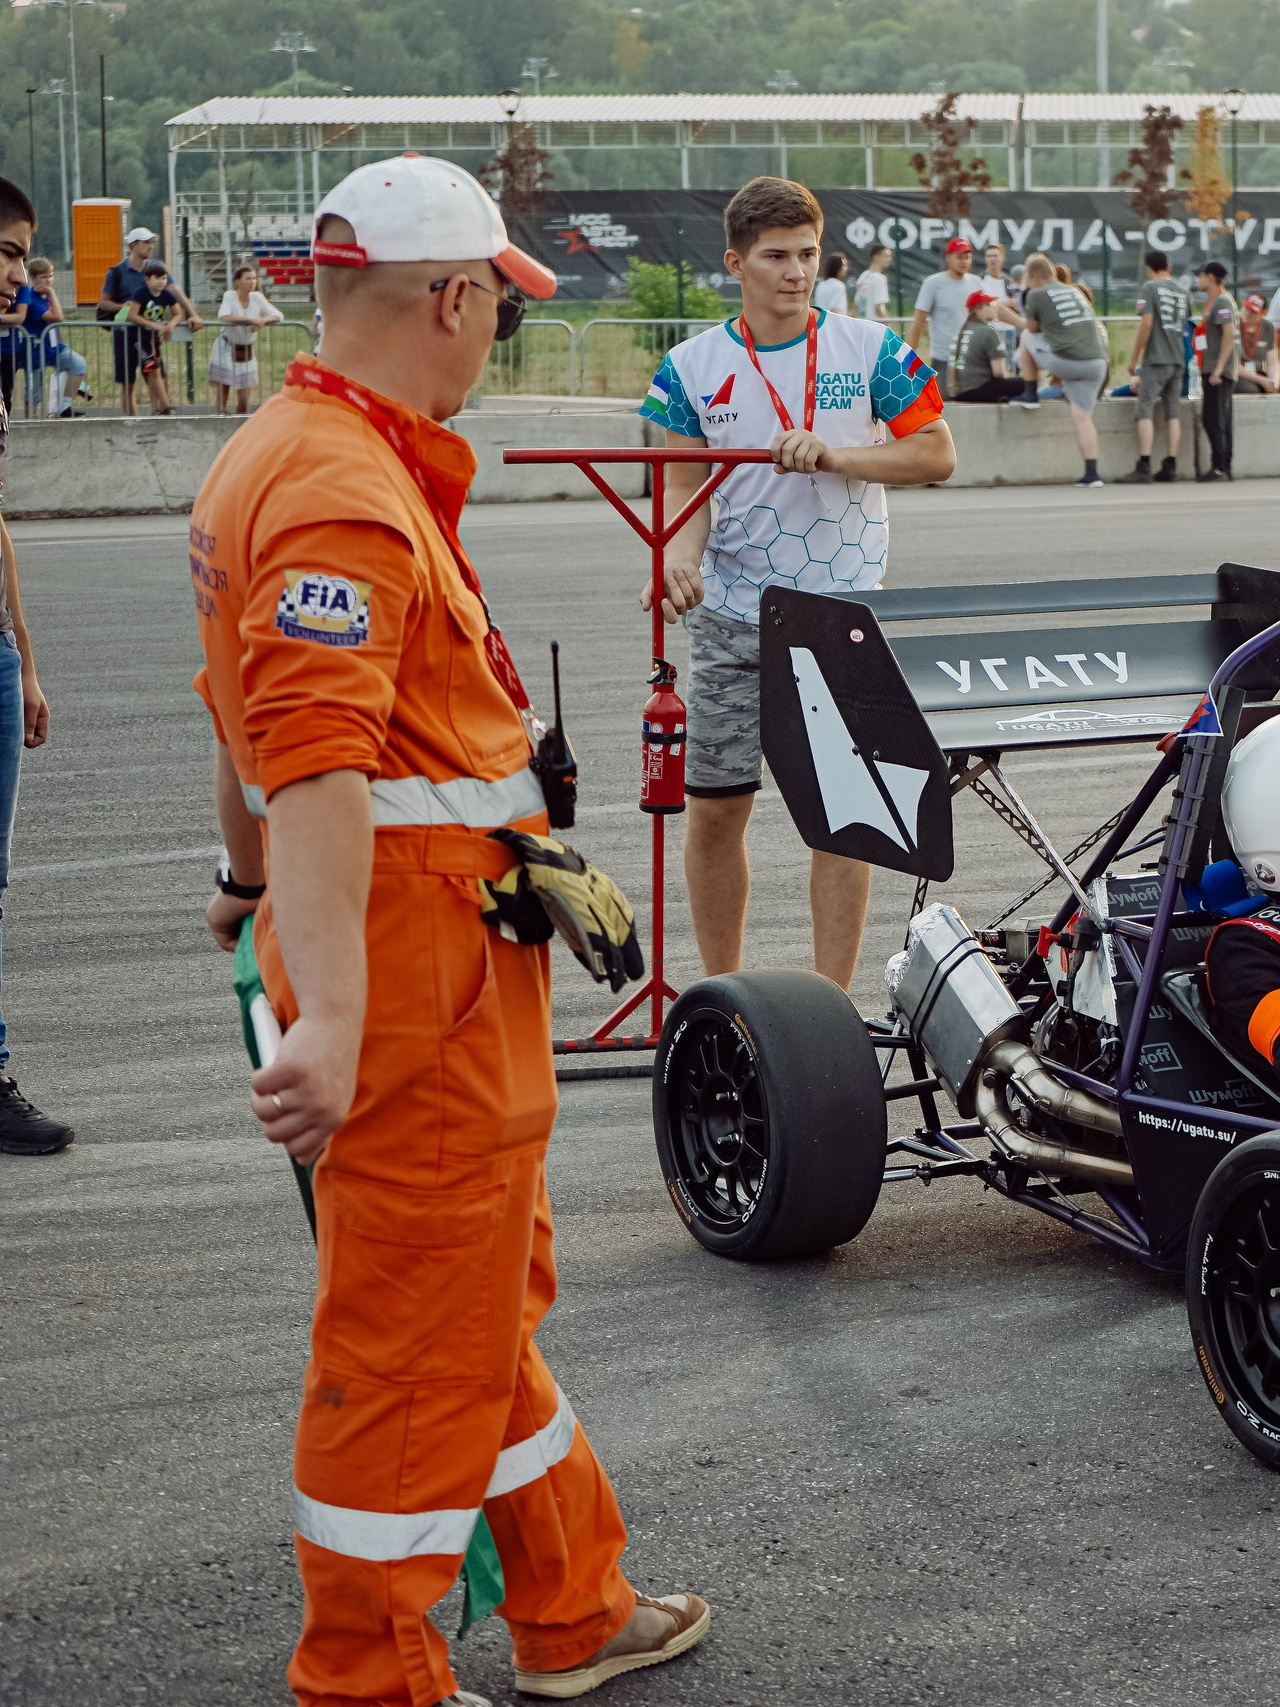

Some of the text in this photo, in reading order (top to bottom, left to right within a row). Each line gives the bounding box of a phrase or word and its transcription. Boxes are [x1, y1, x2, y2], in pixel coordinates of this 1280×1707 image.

[705, 412, 739, 425] УГАТУ
[287, 625, 358, 647] VOLUNTEER
[935, 651, 1129, 694] УГАТУ
[1138, 1110, 1237, 1145] https://ugatu.su/
